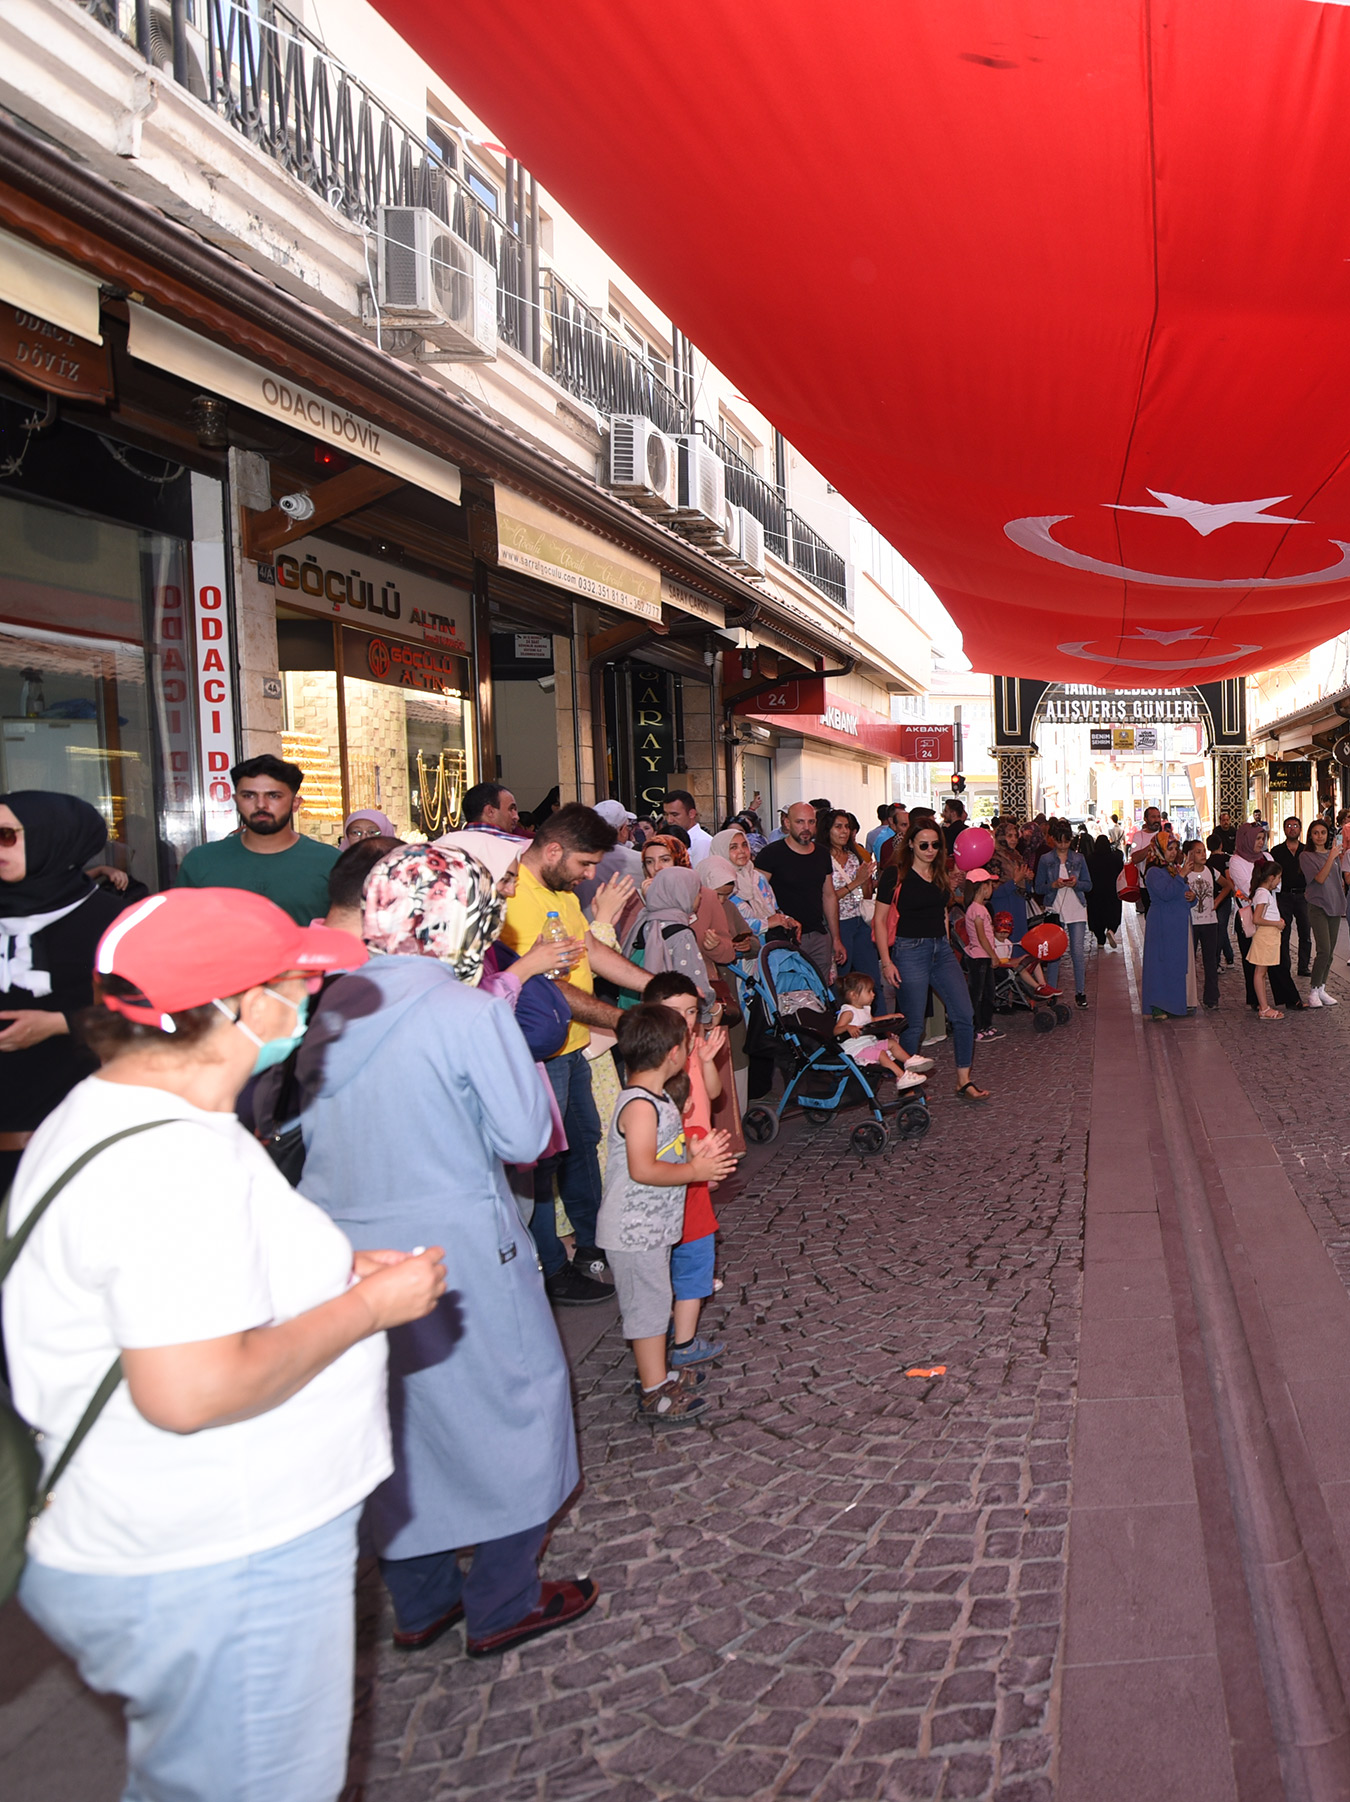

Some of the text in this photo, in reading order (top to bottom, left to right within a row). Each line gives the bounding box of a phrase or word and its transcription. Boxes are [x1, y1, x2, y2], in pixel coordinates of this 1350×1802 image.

[16, 342, 79, 381] DÖVİZ
[262, 378, 381, 456] ODACI DÖVİZ
[276, 554, 400, 620] GÖÇÜLÜ
[409, 607, 456, 636] ALTIN
[199, 585, 226, 733] ODACI
[391, 645, 452, 674] GÖÇÜLÜ
[402, 669, 446, 691] ALTIN
[768, 694, 786, 706] 24
[1046, 700, 1199, 720] ALIŞVERİŞ GÜNLERİ
[820, 705, 858, 736] AKBANK
[921, 750, 933, 758] 24
